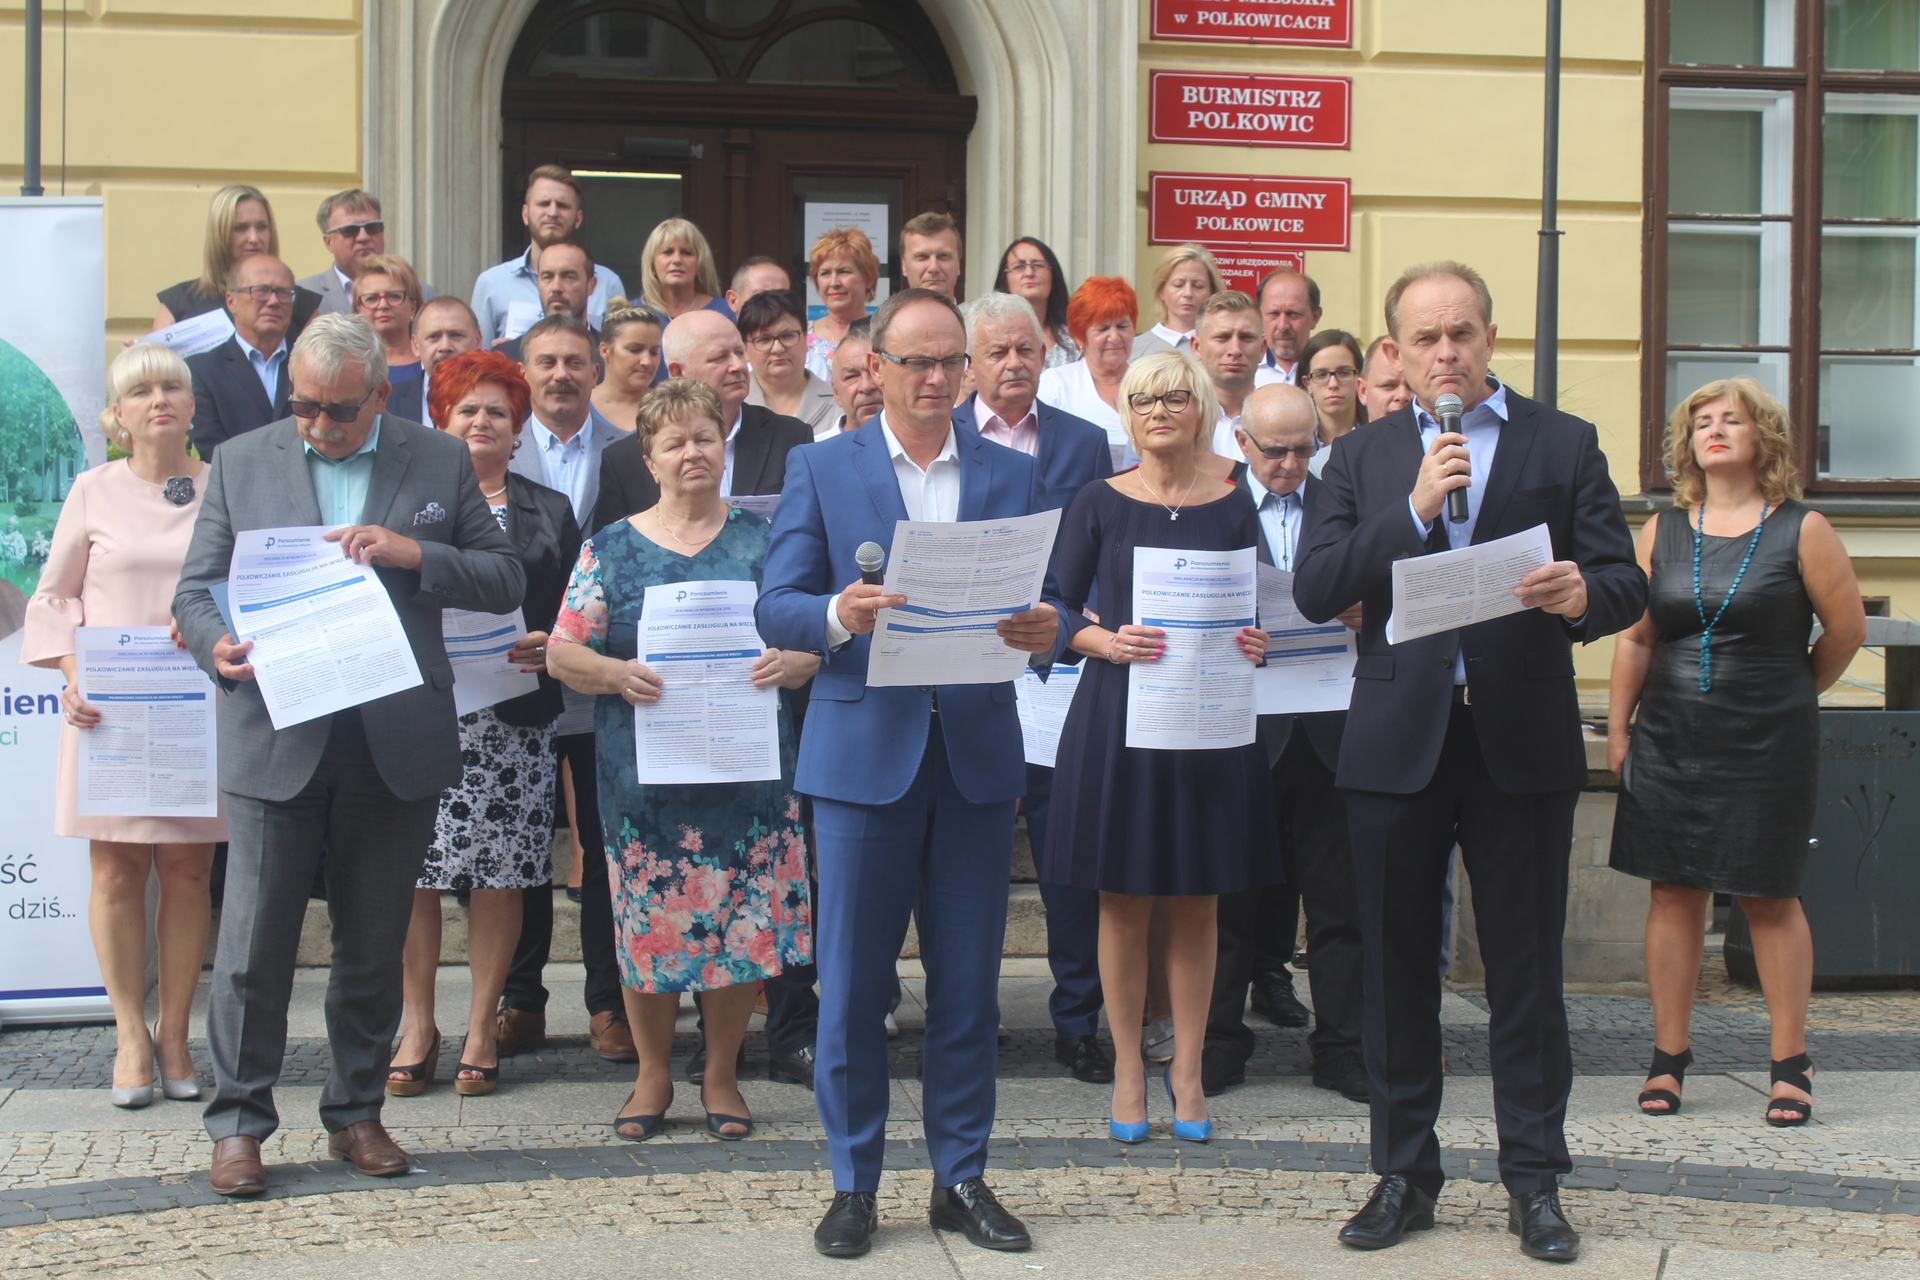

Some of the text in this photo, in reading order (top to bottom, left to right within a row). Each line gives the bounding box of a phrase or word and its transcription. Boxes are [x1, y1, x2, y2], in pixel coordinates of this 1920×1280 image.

[1174, 11, 1331, 30] w POLKOWICACH
[1182, 86, 1321, 108] BURMISTRZ
[1188, 111, 1314, 132] POLKOWIC
[1174, 189, 1327, 210] URZĄD GMINY
[1196, 216, 1304, 232] POLKOWICE
[1236, 258, 1293, 267] URZĘDOWANIA
